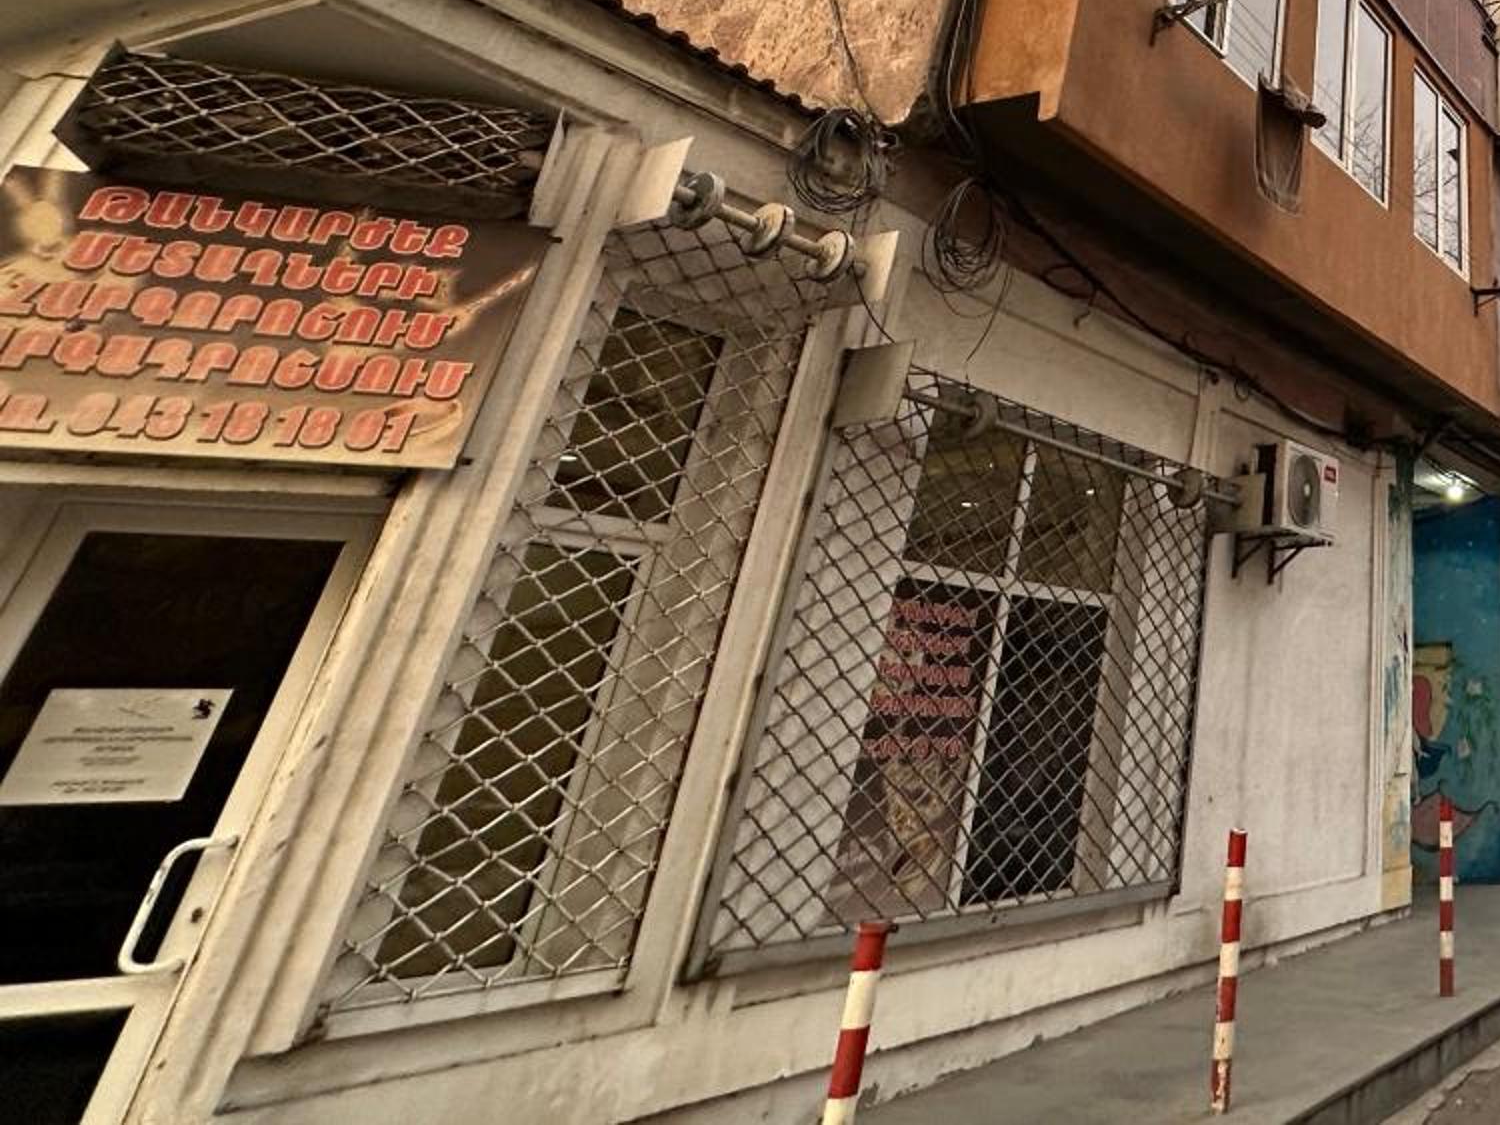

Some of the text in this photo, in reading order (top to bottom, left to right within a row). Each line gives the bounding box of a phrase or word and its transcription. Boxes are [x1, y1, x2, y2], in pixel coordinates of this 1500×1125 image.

[63, 231, 440, 300] ՄԵՏԱՂՆԵՐԻ
[197, 399, 270, 445] 18
[273, 405, 343, 449] 18
